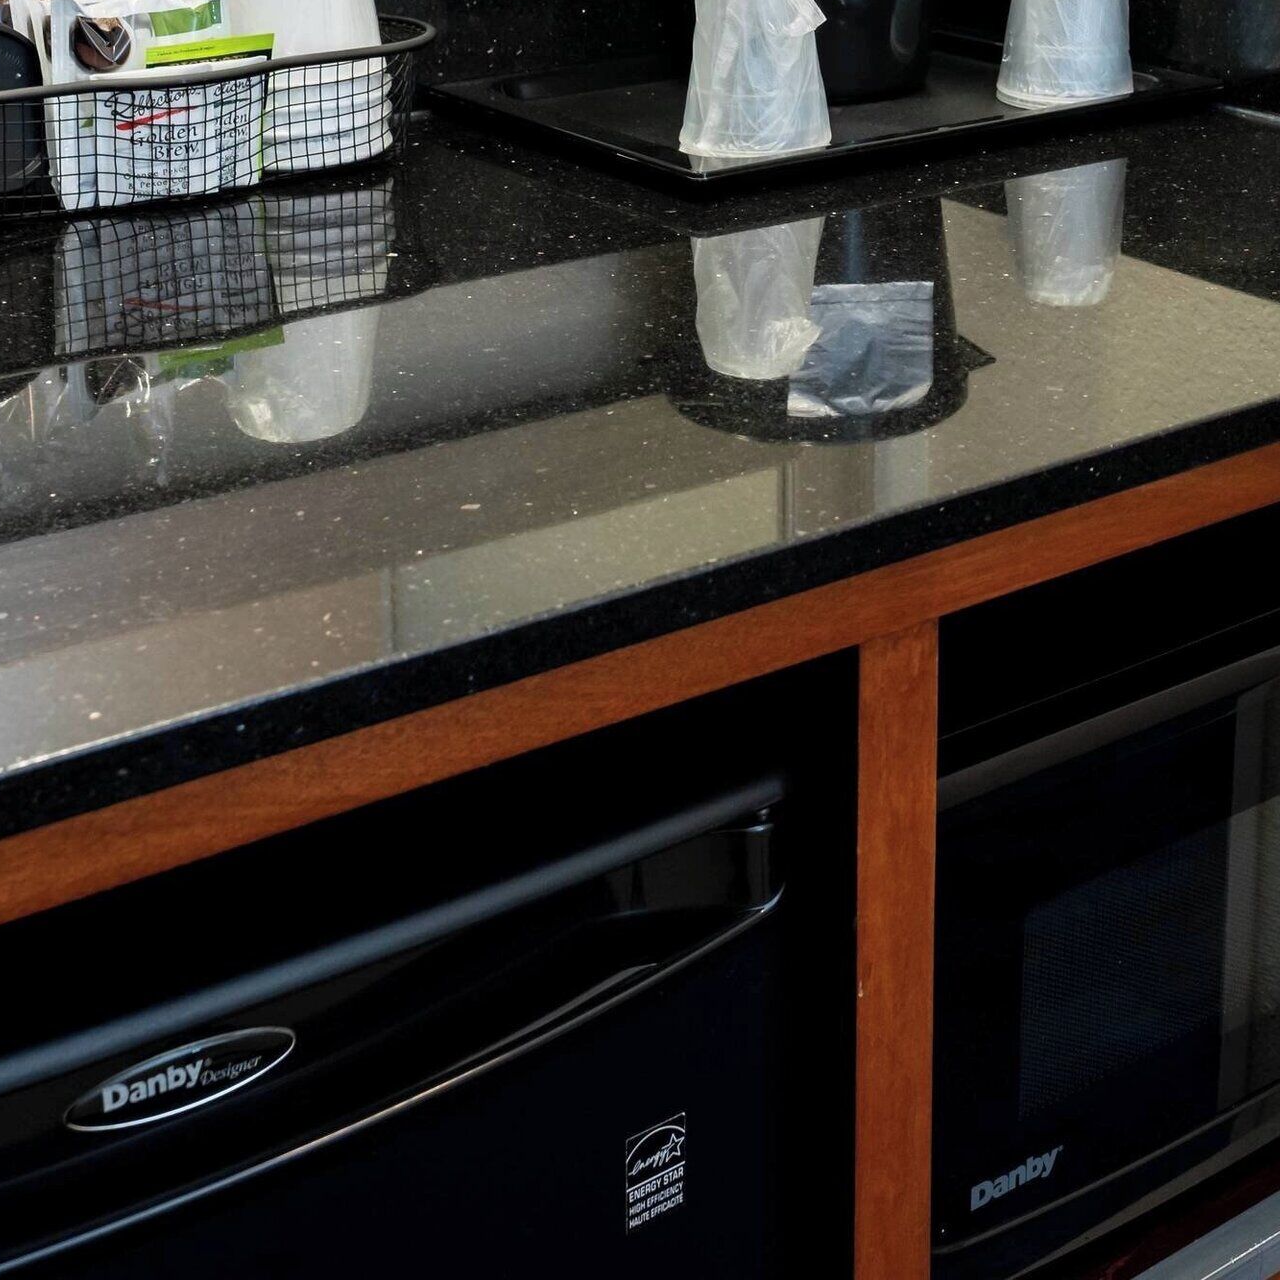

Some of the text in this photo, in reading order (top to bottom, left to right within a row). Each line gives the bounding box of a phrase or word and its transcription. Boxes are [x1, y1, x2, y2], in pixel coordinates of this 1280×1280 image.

[101, 1055, 261, 1113] Danby Designer
[628, 1166, 684, 1203] ENERGY STAR
[970, 1148, 1058, 1211] Danby
[628, 1181, 684, 1217] HIGH EFFICIENCY
[628, 1212, 650, 1230] HAUTE
